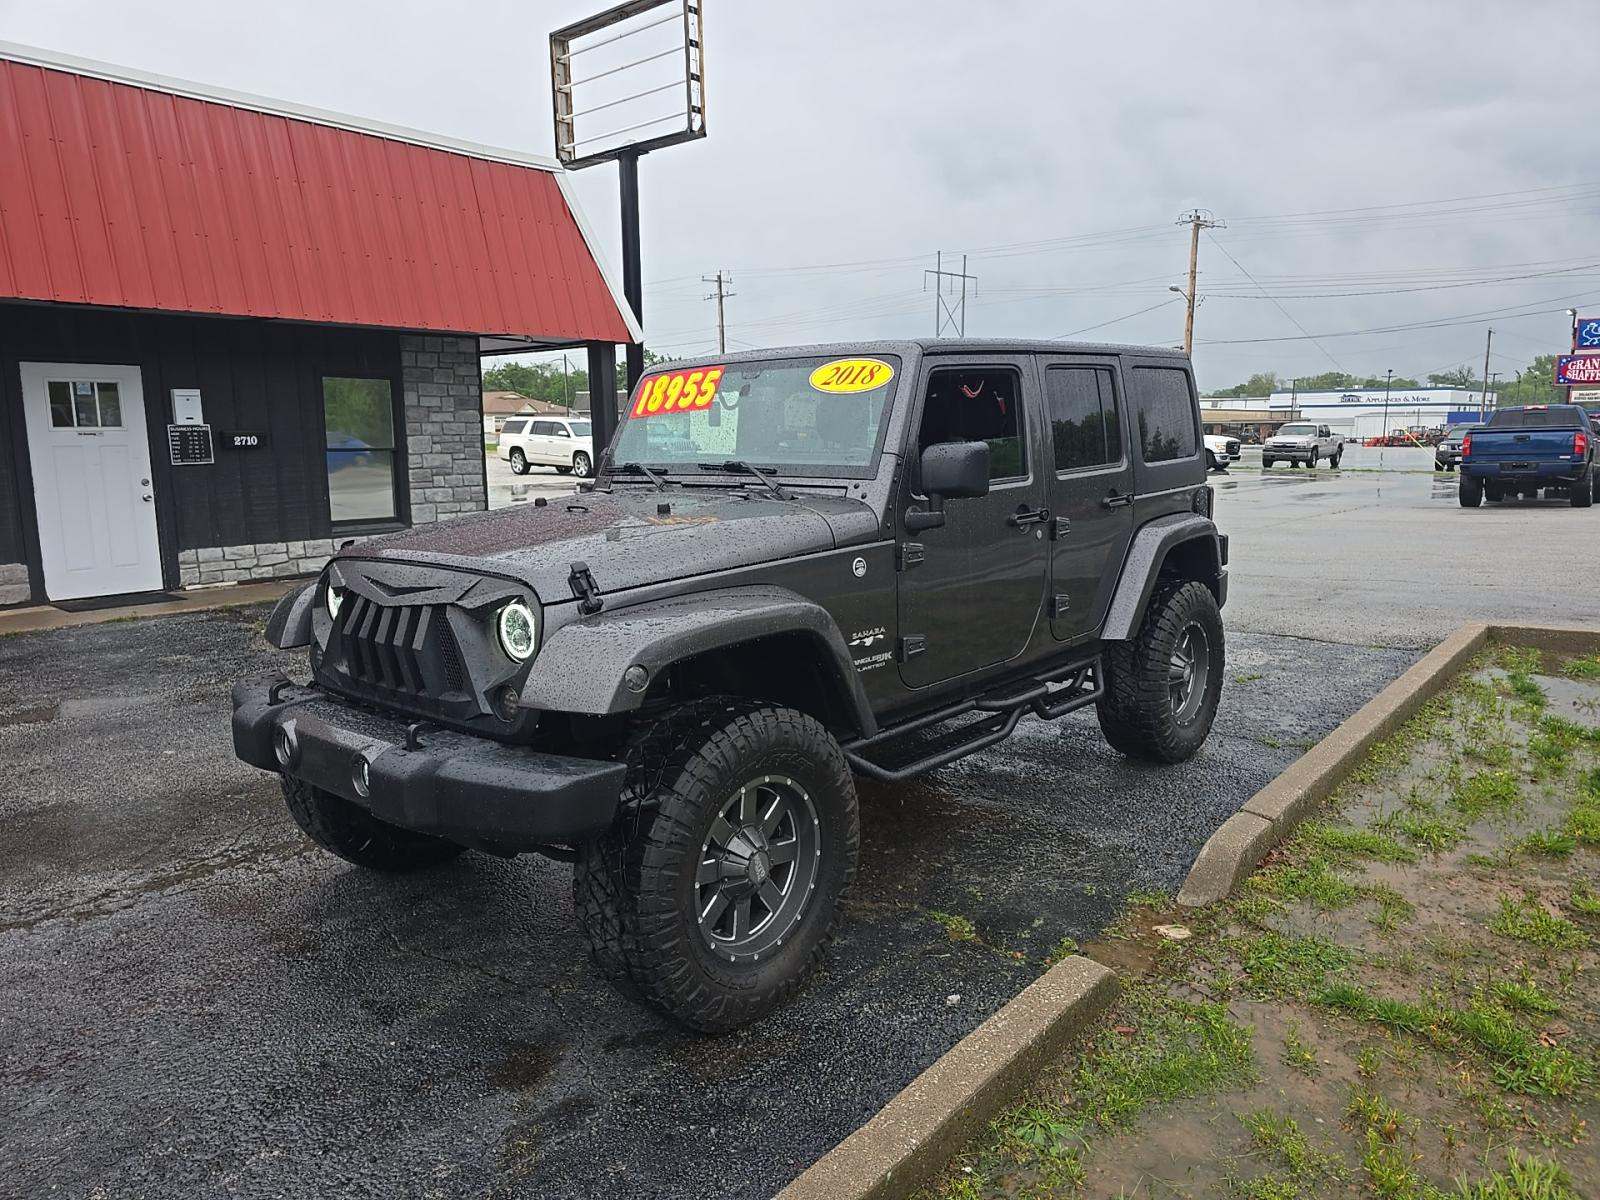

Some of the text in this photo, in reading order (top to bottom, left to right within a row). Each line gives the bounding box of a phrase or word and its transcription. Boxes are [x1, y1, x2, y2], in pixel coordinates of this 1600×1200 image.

[820, 364, 882, 386] 2018
[636, 369, 722, 415] 18955
[233, 436, 258, 446] 2710
